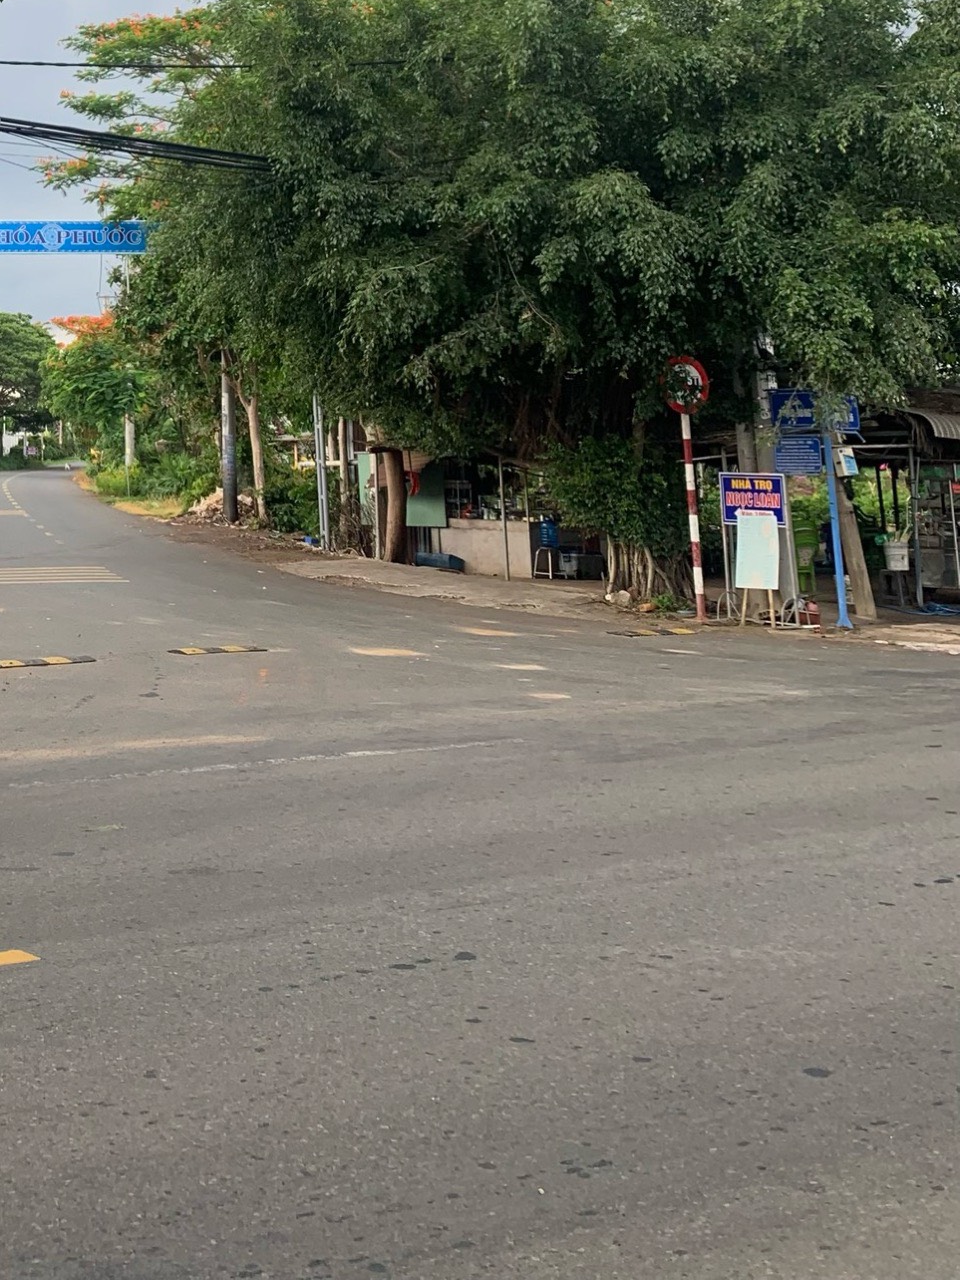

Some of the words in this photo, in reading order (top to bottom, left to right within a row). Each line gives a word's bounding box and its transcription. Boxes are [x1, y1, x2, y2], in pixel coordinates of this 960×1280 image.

[55, 226, 142, 245] PHƯỚC
[731, 478, 752, 489] NHÀ
[753, 480, 773, 492] TRỌ
[725, 491, 753, 509] NGỌC
[753, 492, 781, 508] LOAN
